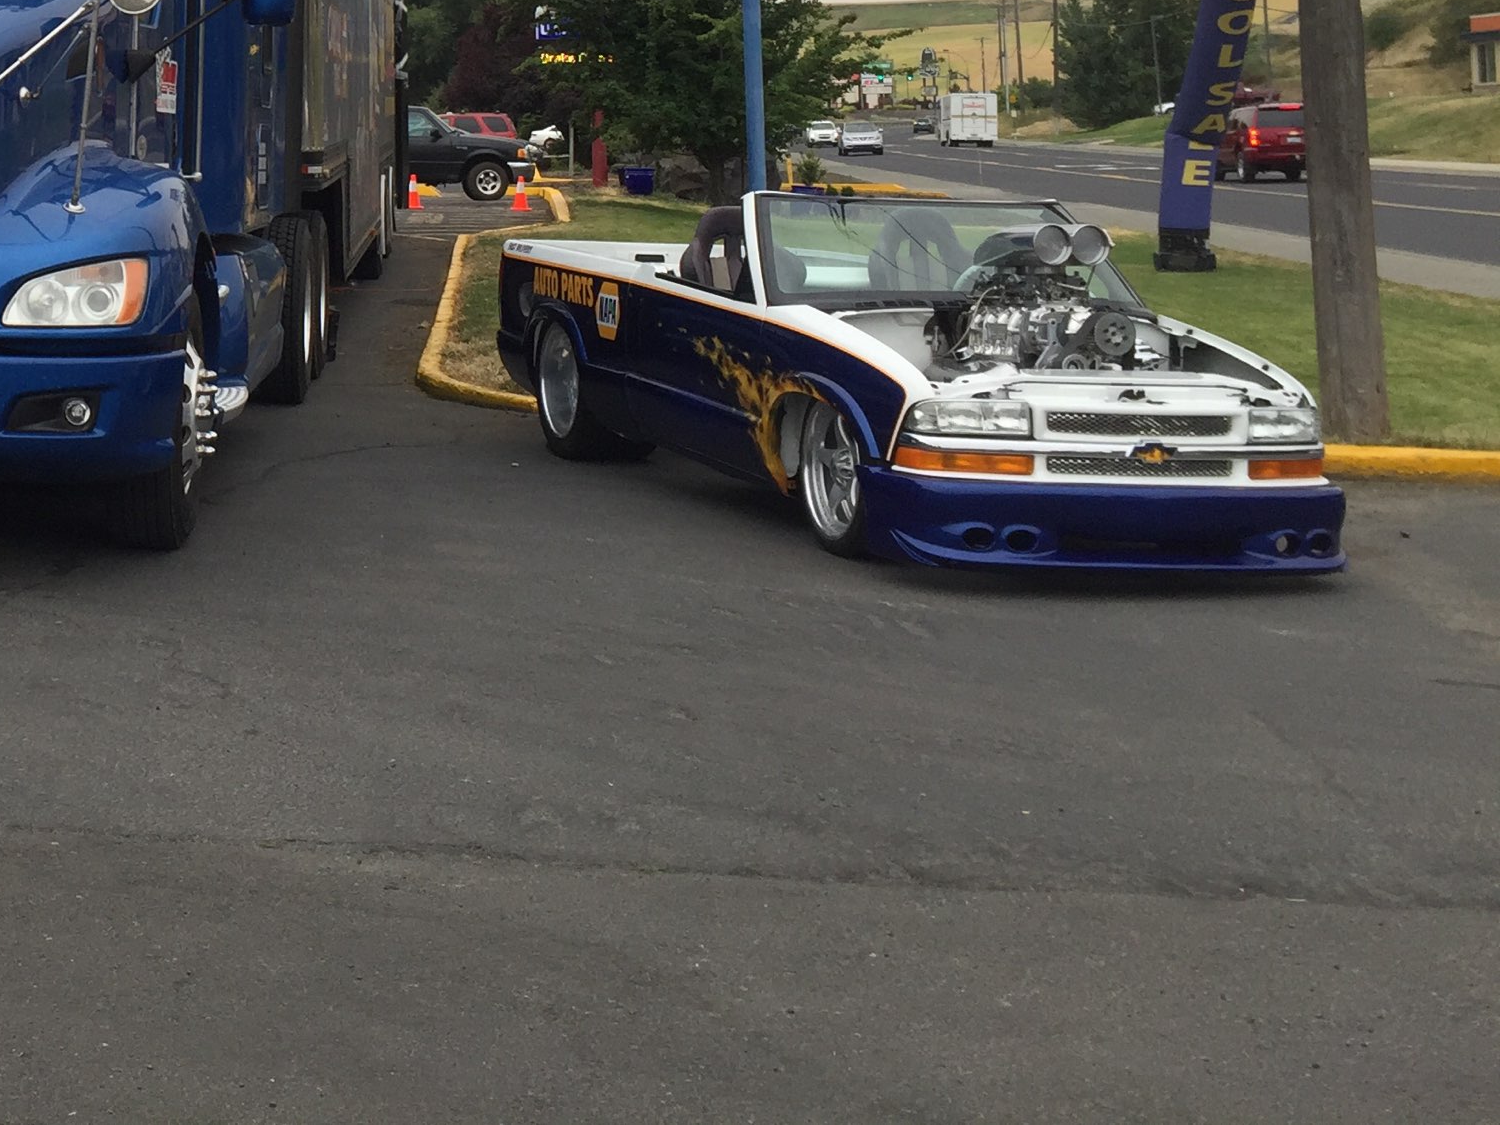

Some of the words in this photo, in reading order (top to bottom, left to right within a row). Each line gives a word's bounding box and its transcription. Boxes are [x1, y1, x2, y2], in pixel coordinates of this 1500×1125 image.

[1180, 81, 1238, 187] SAE
[533, 266, 559, 299] AUTO
[561, 272, 594, 308] PARTS
[599, 296, 617, 325] NAPA
